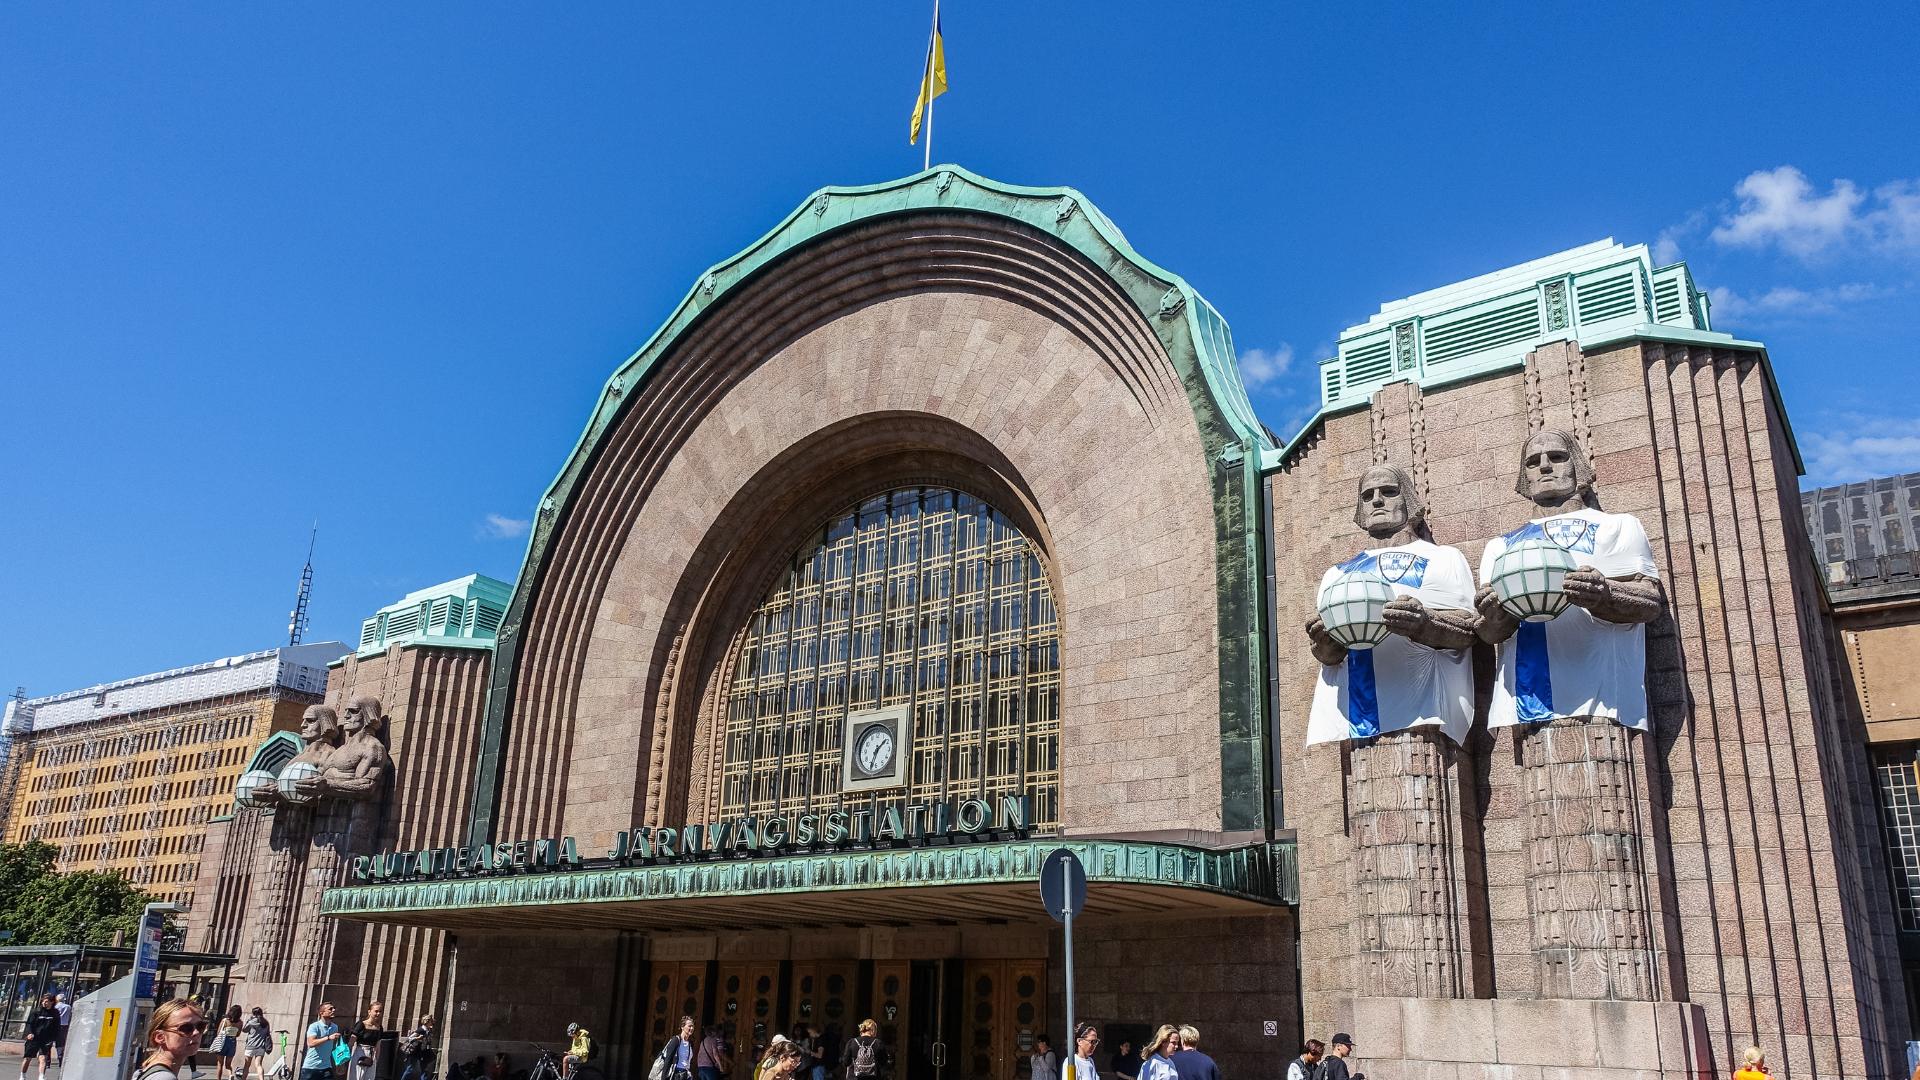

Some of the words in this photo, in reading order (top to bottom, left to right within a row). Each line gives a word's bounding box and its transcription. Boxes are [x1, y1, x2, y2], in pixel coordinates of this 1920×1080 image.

[352, 837, 578, 880] RAUTATIEASEMA
[608, 795, 1029, 861] JÄRNVÄGSSTATION
[109, 1009, 115, 1027] 1
[885, 1006, 897, 1014] VR
